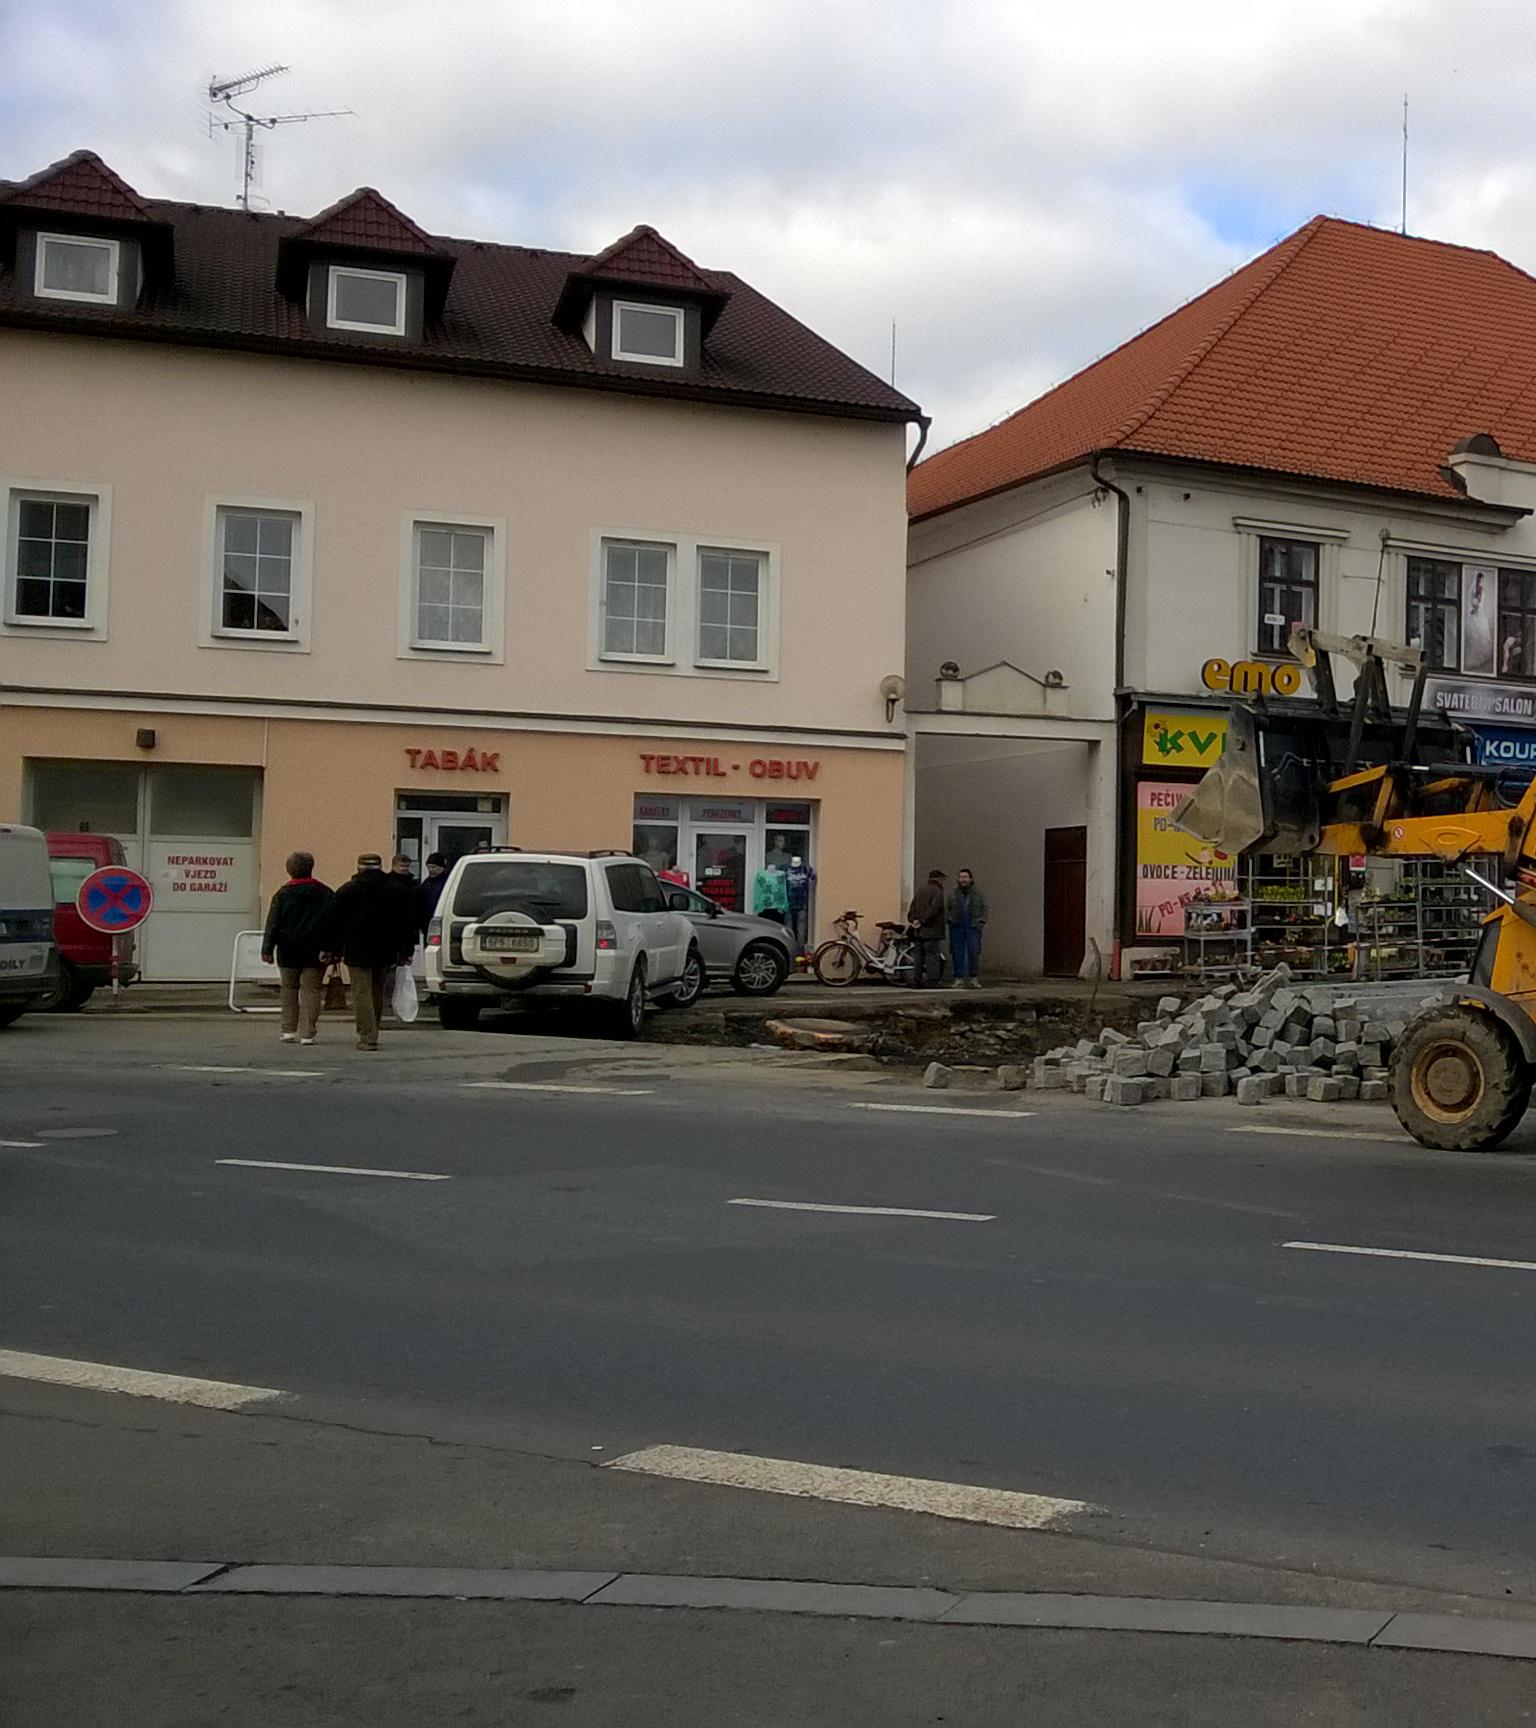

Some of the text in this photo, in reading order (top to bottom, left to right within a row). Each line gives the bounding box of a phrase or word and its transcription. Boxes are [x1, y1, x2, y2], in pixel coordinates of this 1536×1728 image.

[1201, 658, 1300, 696] emo
[1495, 697, 1533, 715] SALON
[404, 747, 500, 772] TABÁK
[640, 753, 726, 777] TEXTIL
[749, 758, 820, 780] OBUV
[167, 856, 234, 866] NEPARKOVAT
[184, 869, 217, 879] VJEZD
[173, 882, 187, 892] DO
